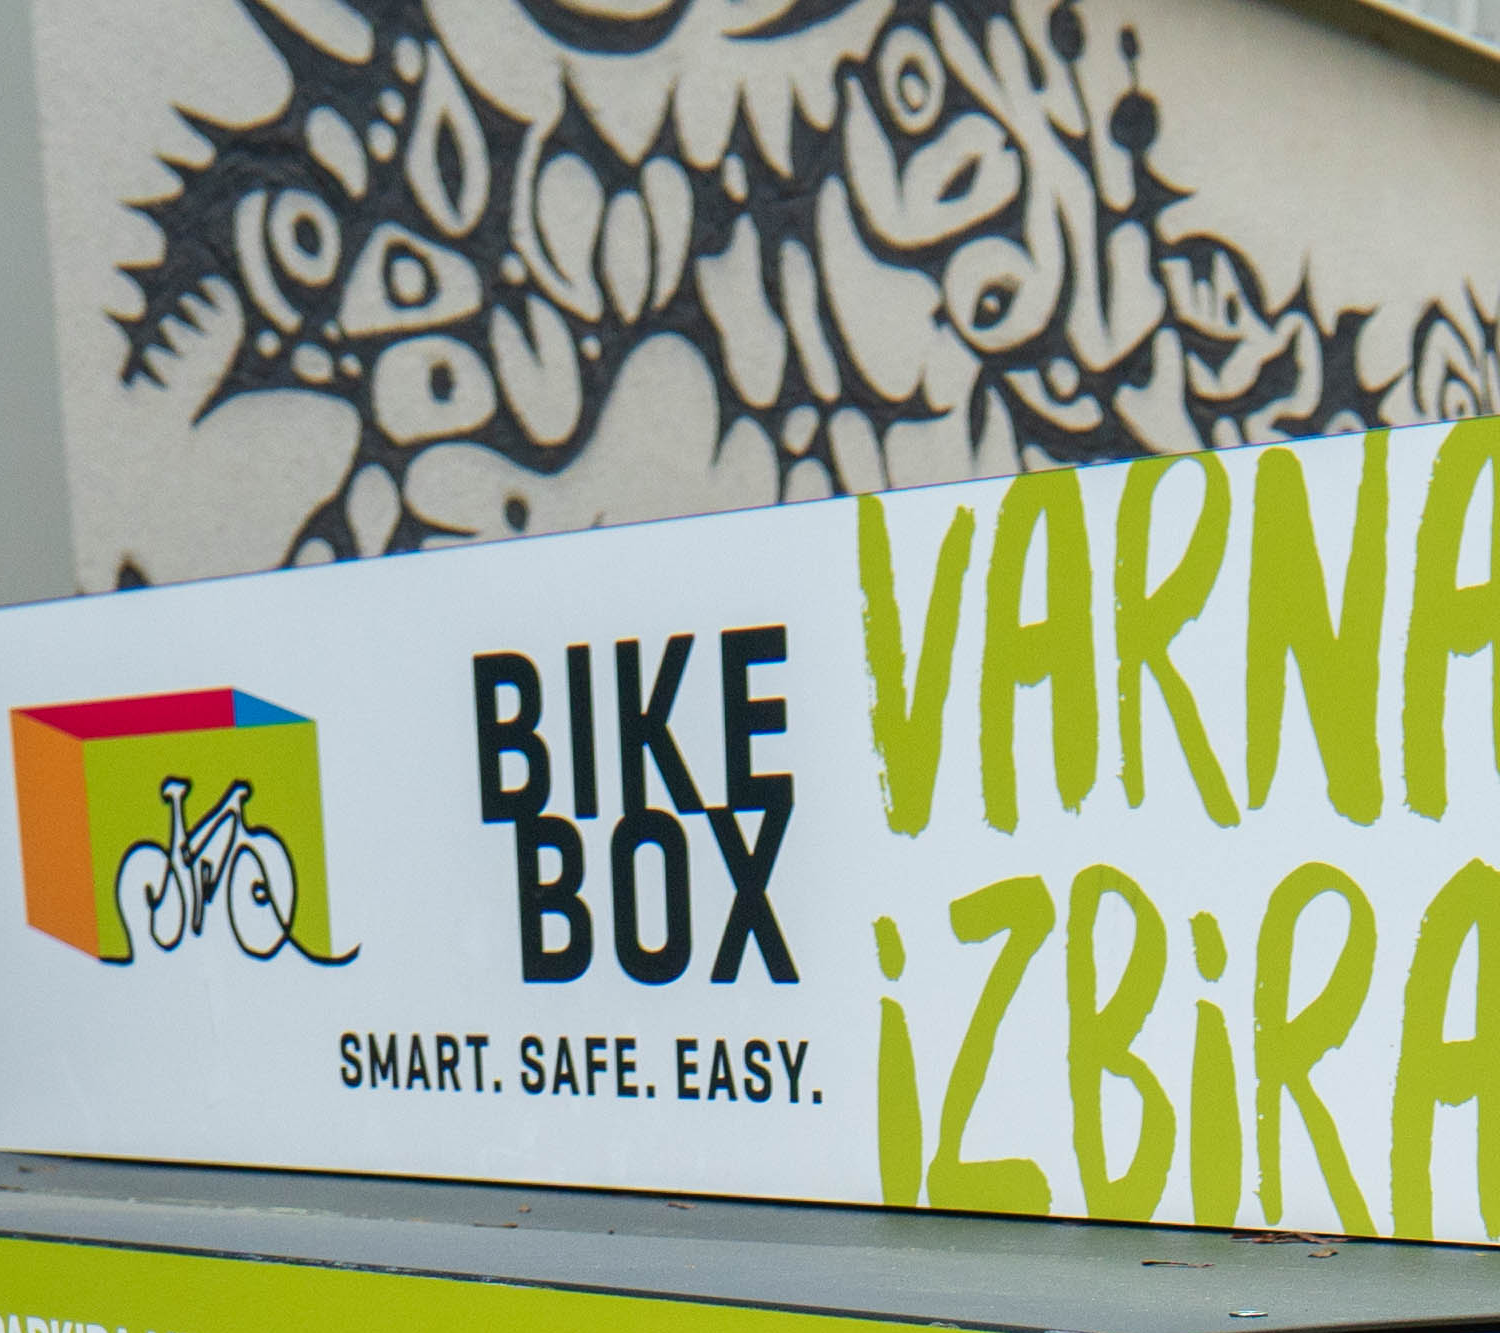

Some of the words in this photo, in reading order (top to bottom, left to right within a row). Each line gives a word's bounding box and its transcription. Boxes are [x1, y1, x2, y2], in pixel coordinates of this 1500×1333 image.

[472, 624, 796, 824] BIKE
[515, 804, 801, 986] BOX
[340, 1031, 502, 1093] SMART.
[520, 1034, 656, 1099] SAFE.
[676, 1037, 823, 1104] EASY.
